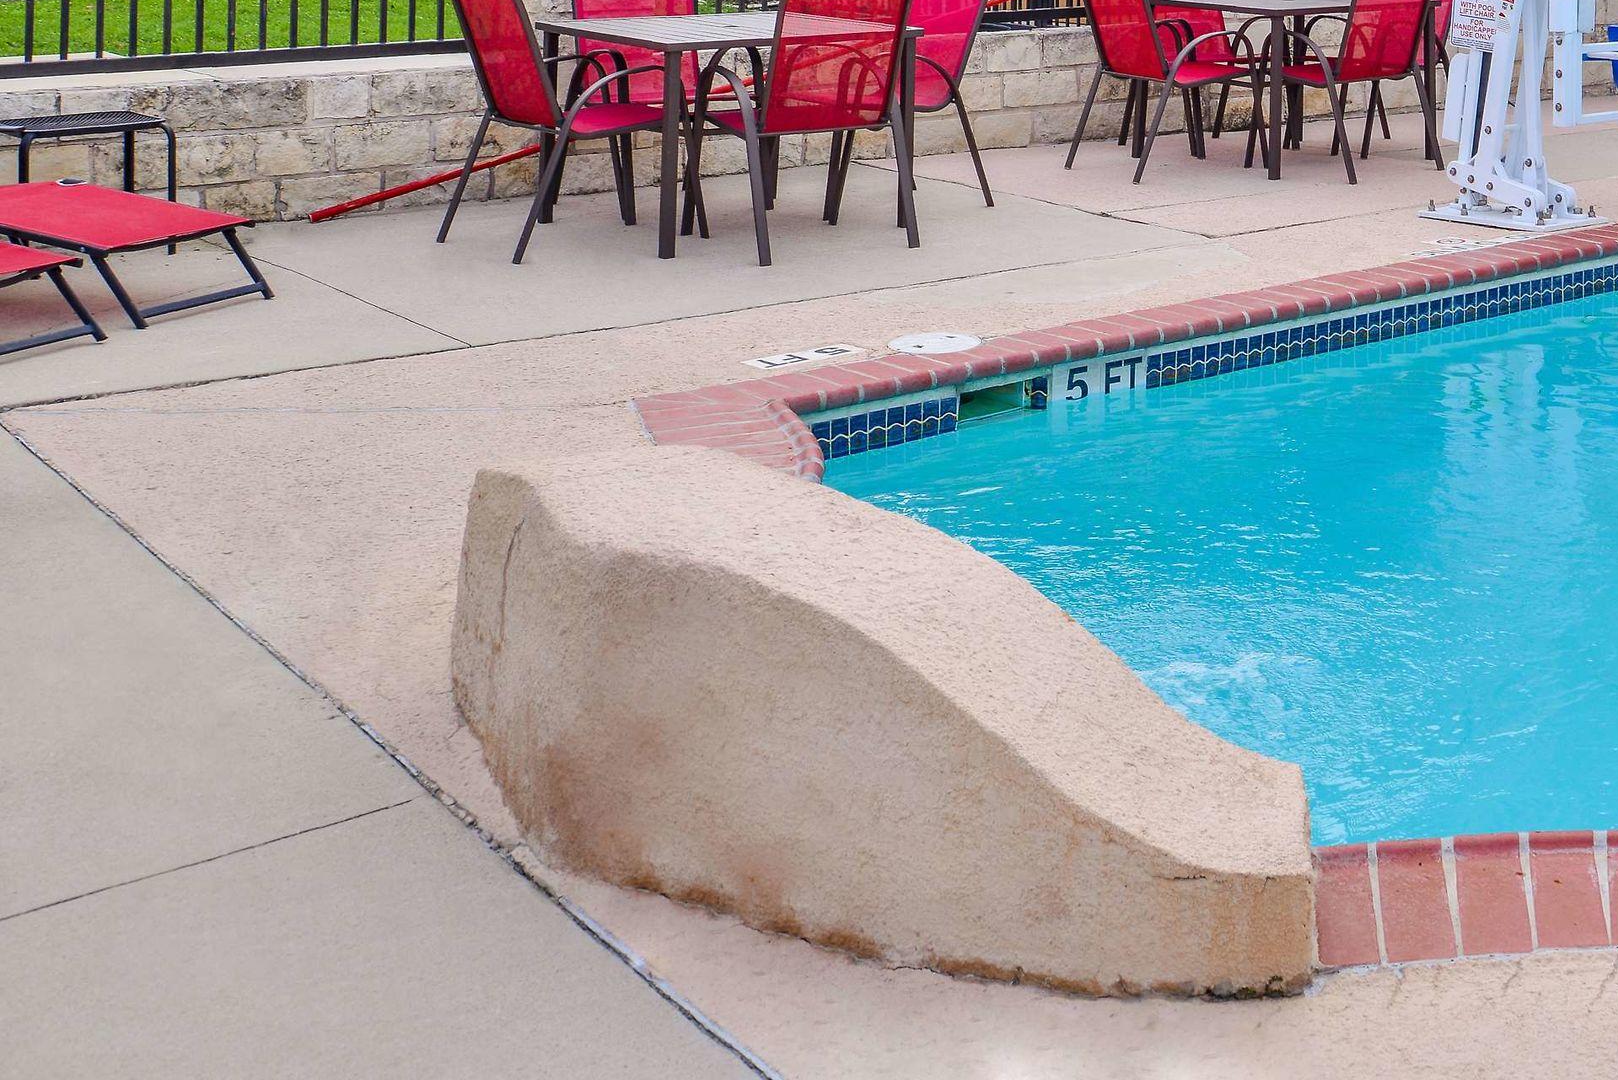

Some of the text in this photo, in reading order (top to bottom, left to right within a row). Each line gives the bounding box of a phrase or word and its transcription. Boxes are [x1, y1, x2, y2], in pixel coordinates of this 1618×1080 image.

[1478, 3, 1496, 12] POOL
[1474, 10, 1494, 18] CHAIR
[1454, 23, 1496, 35] HANDICAPPE
[1066, 356, 1142, 400] 5 FT
